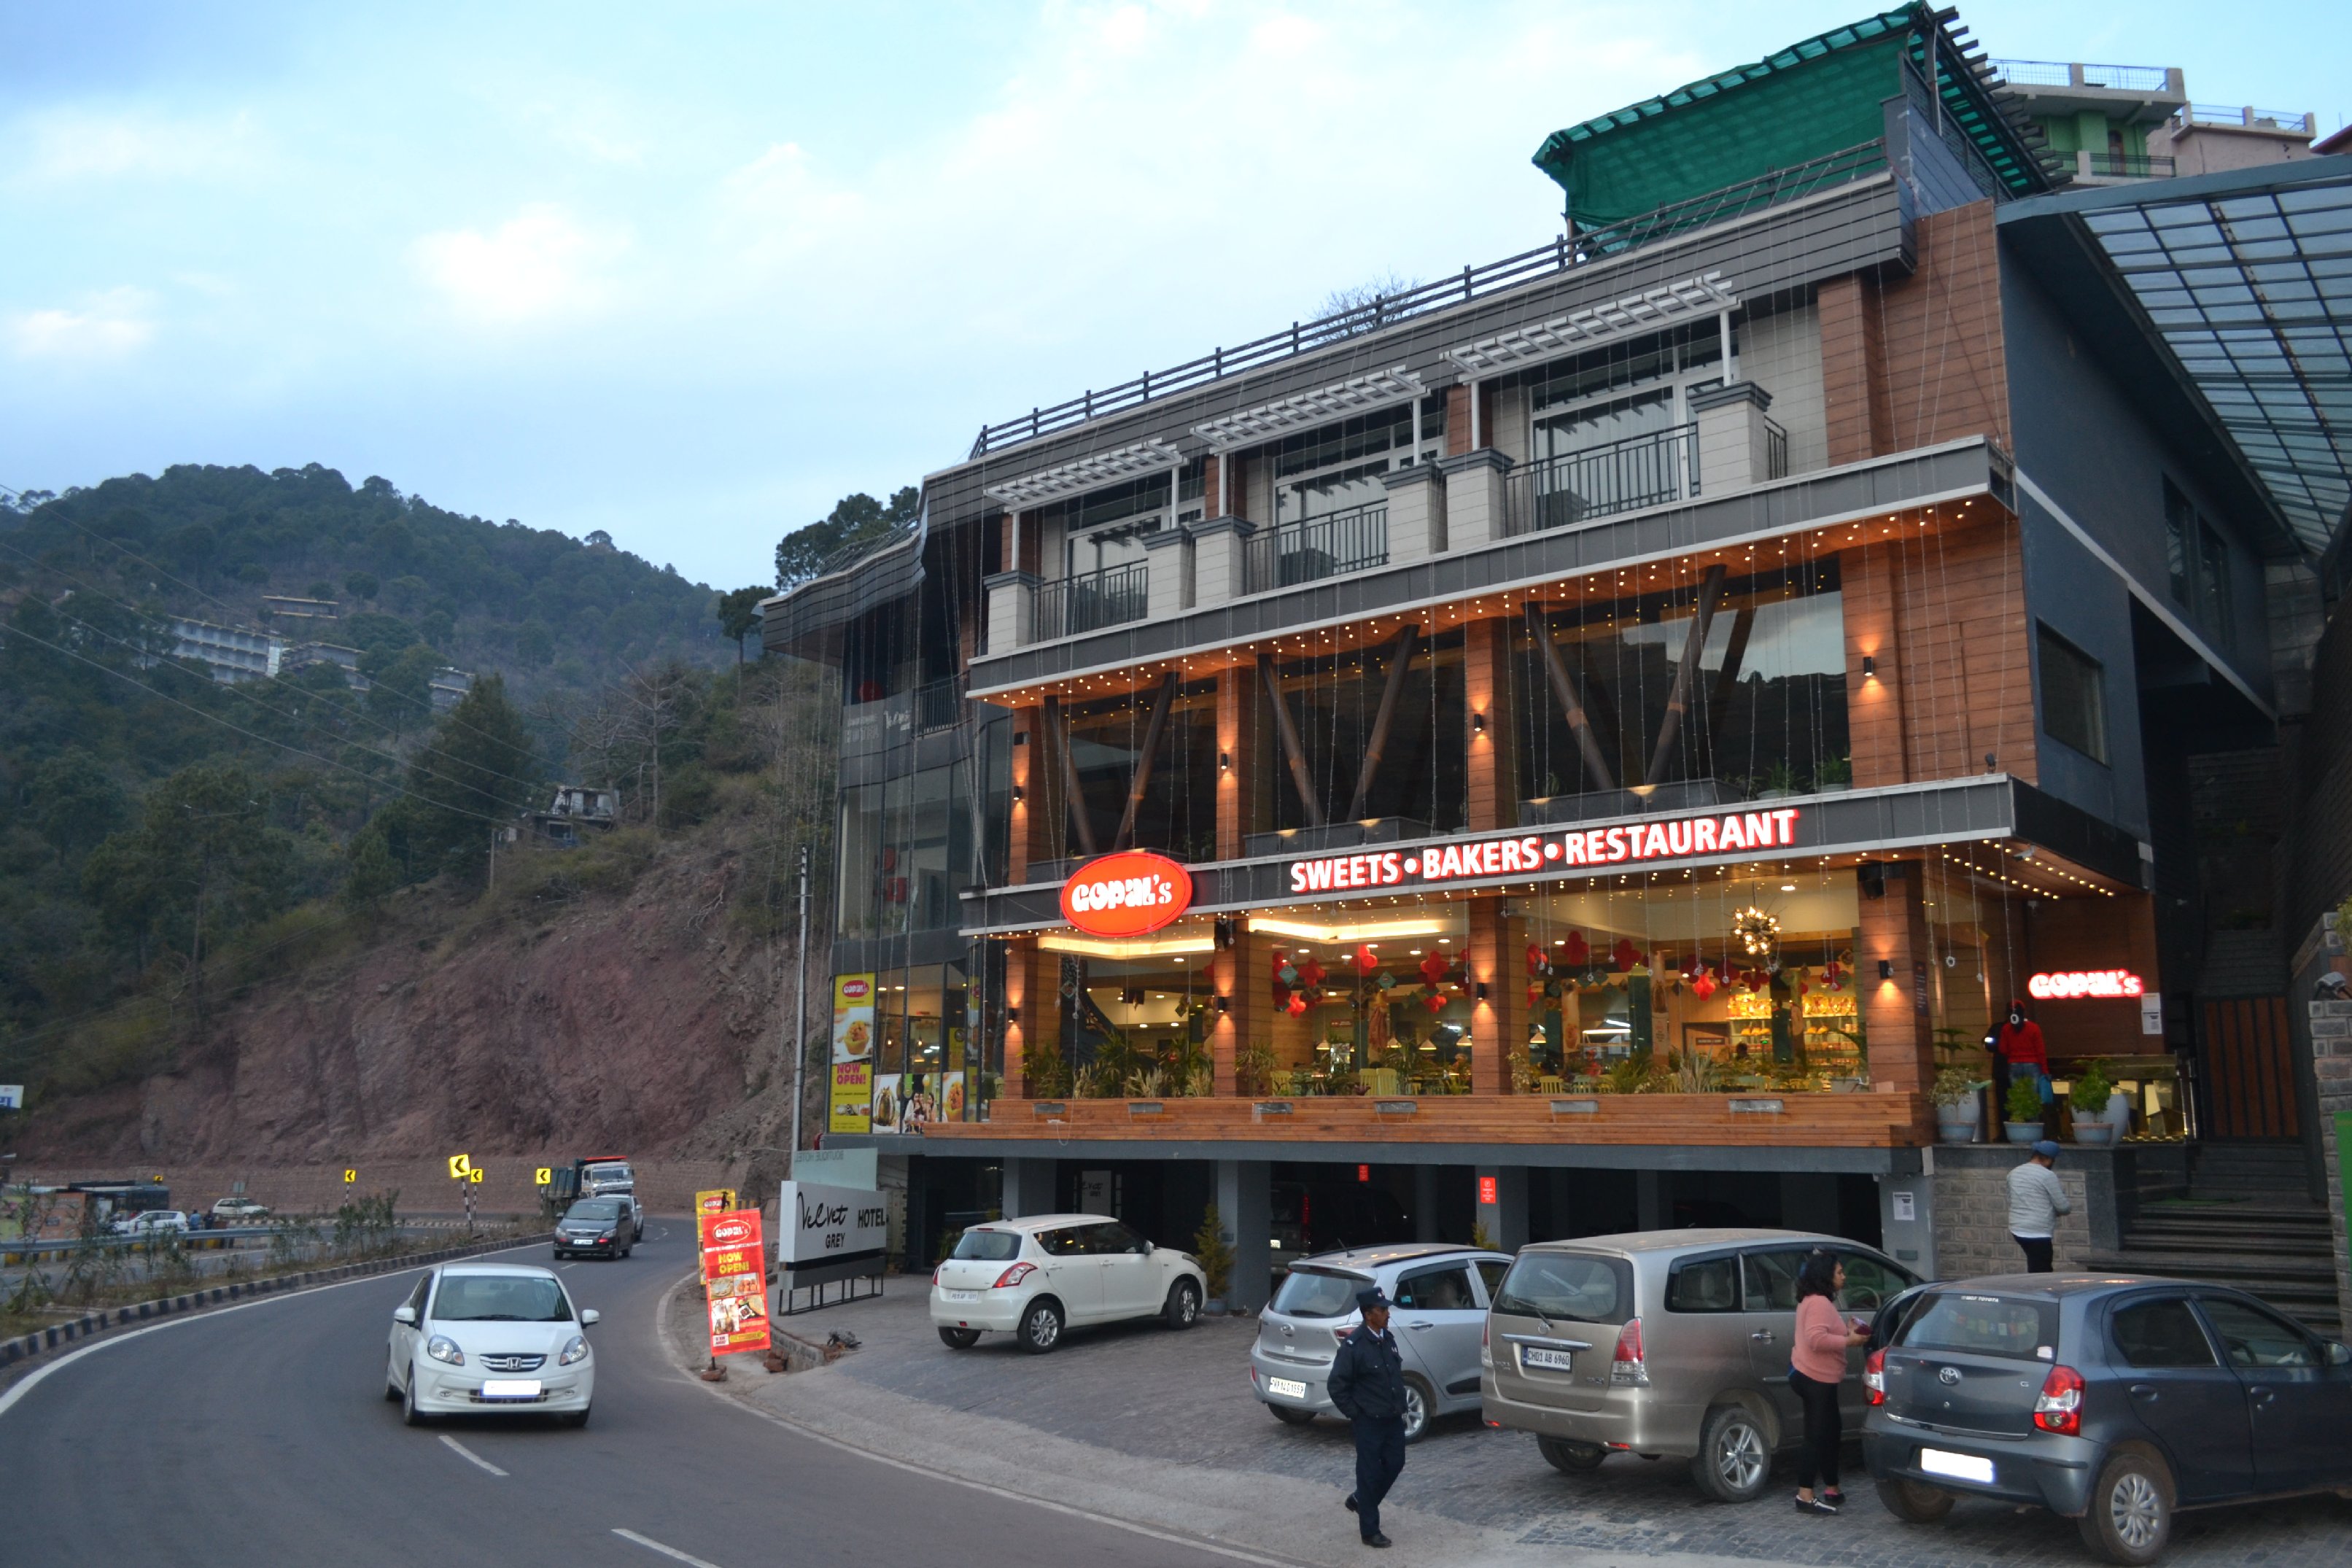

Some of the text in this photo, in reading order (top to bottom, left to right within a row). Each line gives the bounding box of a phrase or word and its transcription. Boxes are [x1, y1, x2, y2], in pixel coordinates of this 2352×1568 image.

[1291, 809, 1799, 893] SWEETS BAKERS RESTAURANT
[837, 1063, 861, 1074] NOW
[837, 1074, 866, 1085] OPEN!
[797, 1191, 885, 1230] Velvet HOTEL
[826, 1233, 845, 1249] GREY
[718, 1251, 742, 1264] NOW
[719, 1261, 749, 1274] OPEN!
[1545, 1353, 1553, 1363] AB
[1554, 1354, 1570, 1365] 6960
